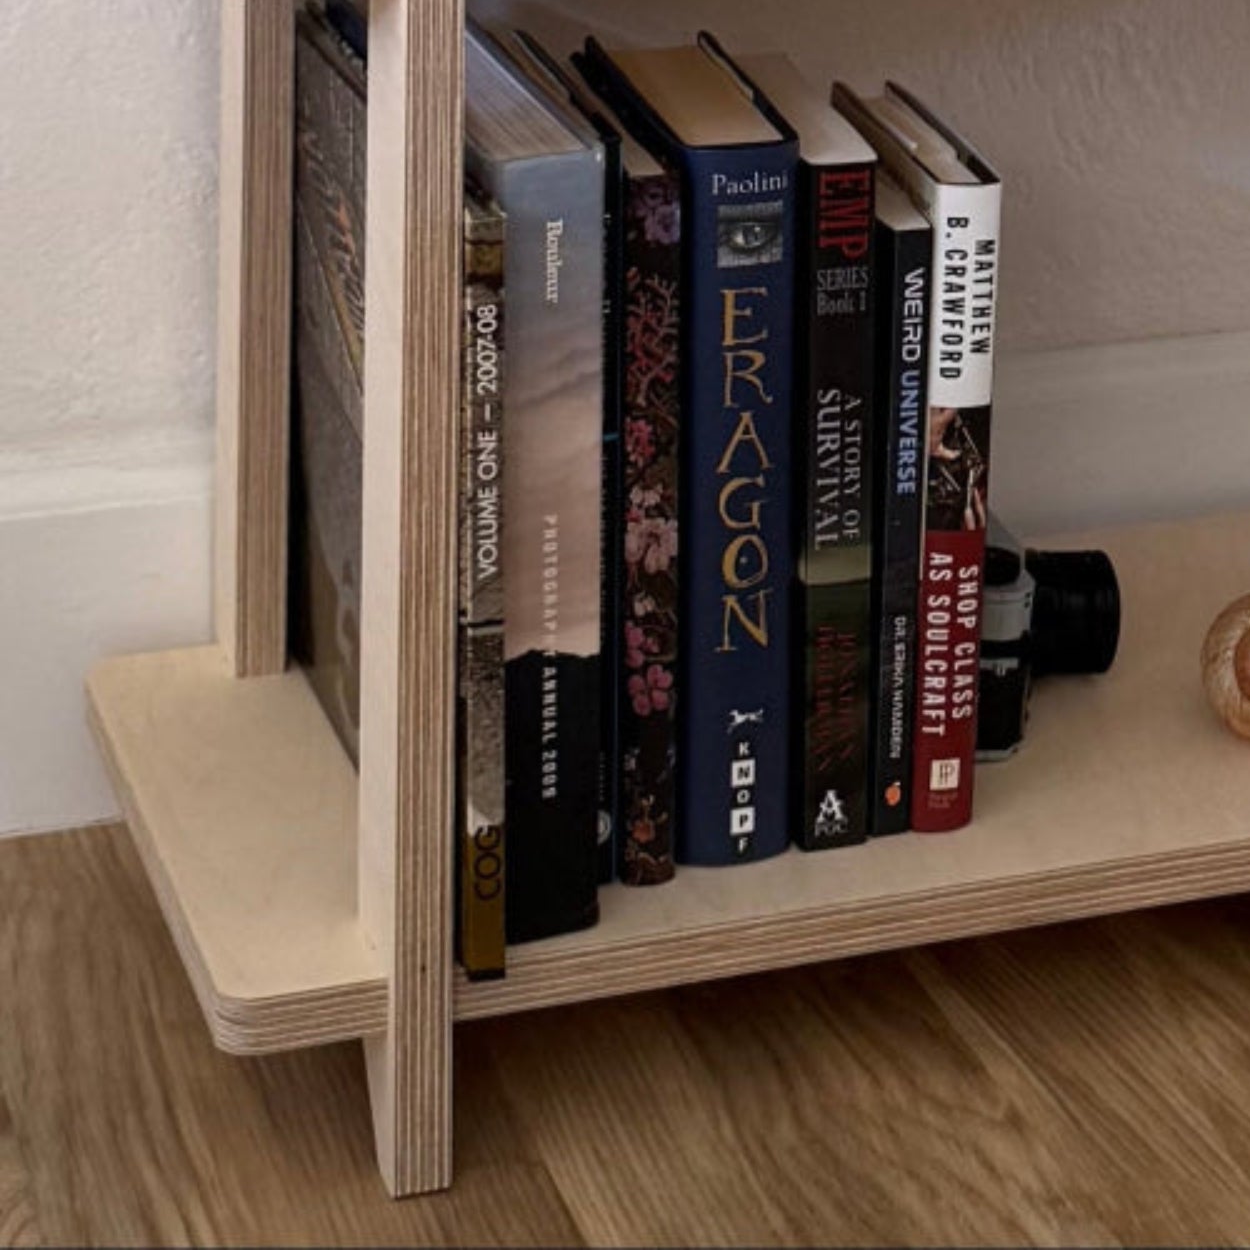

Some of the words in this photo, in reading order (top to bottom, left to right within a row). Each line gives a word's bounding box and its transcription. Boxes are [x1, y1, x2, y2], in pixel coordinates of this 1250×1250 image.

[711, 170, 788, 196] Paolini
[818, 170, 870, 261] EMP
[816, 266, 868, 292] SERIES
[816, 291, 854, 316] Book
[901, 268, 925, 362] WEIRD
[940, 248, 968, 380] CRAWFORD
[970, 239, 995, 354] MATTHEW
[844, 393, 861, 412] A
[897, 374, 922, 494] UNIVERSE
[476, 430, 498, 482] ONE
[716, 287, 773, 652] ERAGON
[815, 389, 841, 551] SURVIVAL
[843, 418, 862, 499] STORY
[476, 482, 498, 581] VOLUME
[842, 508, 861, 540] OF
[929, 552, 953, 581] AS
[956, 565, 979, 628] SHOP
[542, 666, 559, 741] ANNUAL
[922, 595, 951, 737] SOULCRAFT
[952, 642, 977, 719] CLASS
[733, 742, 753, 852] KNOPF
[474, 825, 502, 902] COG
